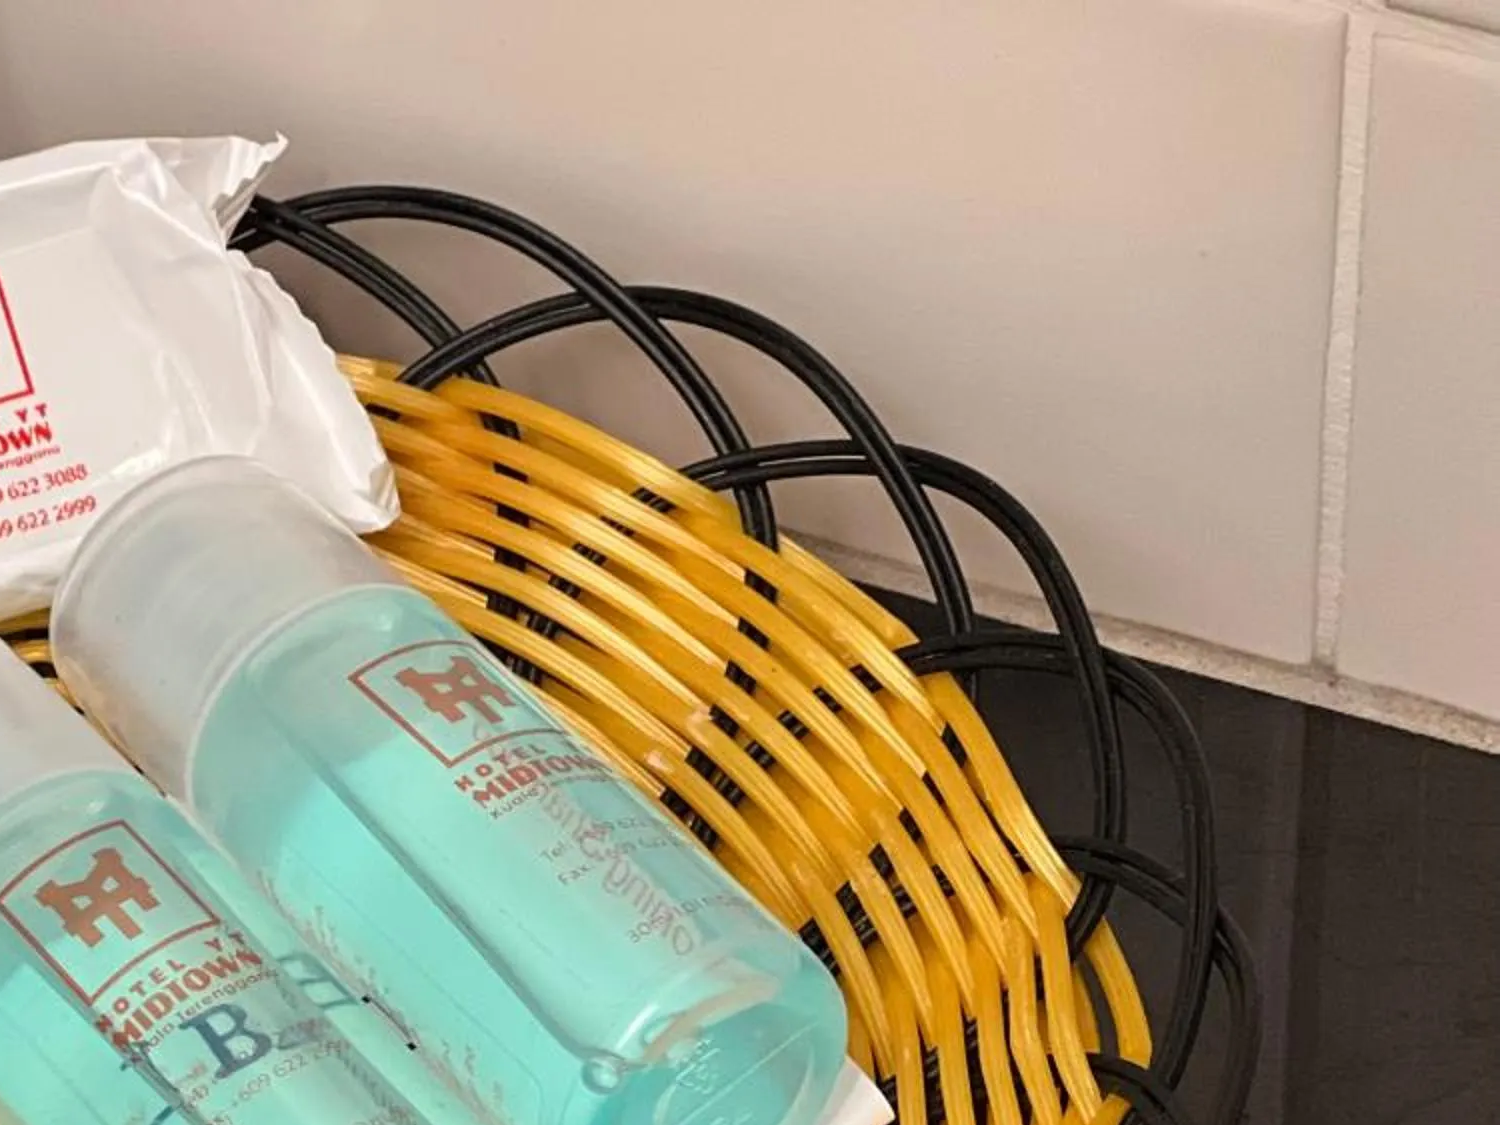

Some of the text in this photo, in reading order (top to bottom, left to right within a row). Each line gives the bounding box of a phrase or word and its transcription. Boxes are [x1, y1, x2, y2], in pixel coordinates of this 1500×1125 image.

[7, 477, 40, 500] 622
[43, 464, 88, 490] 3088
[17, 509, 49, 532] 622
[52, 495, 97, 522] 2999
[94, 959, 186, 1033] HOTEL
[112, 948, 262, 1052] MIDTOWN
